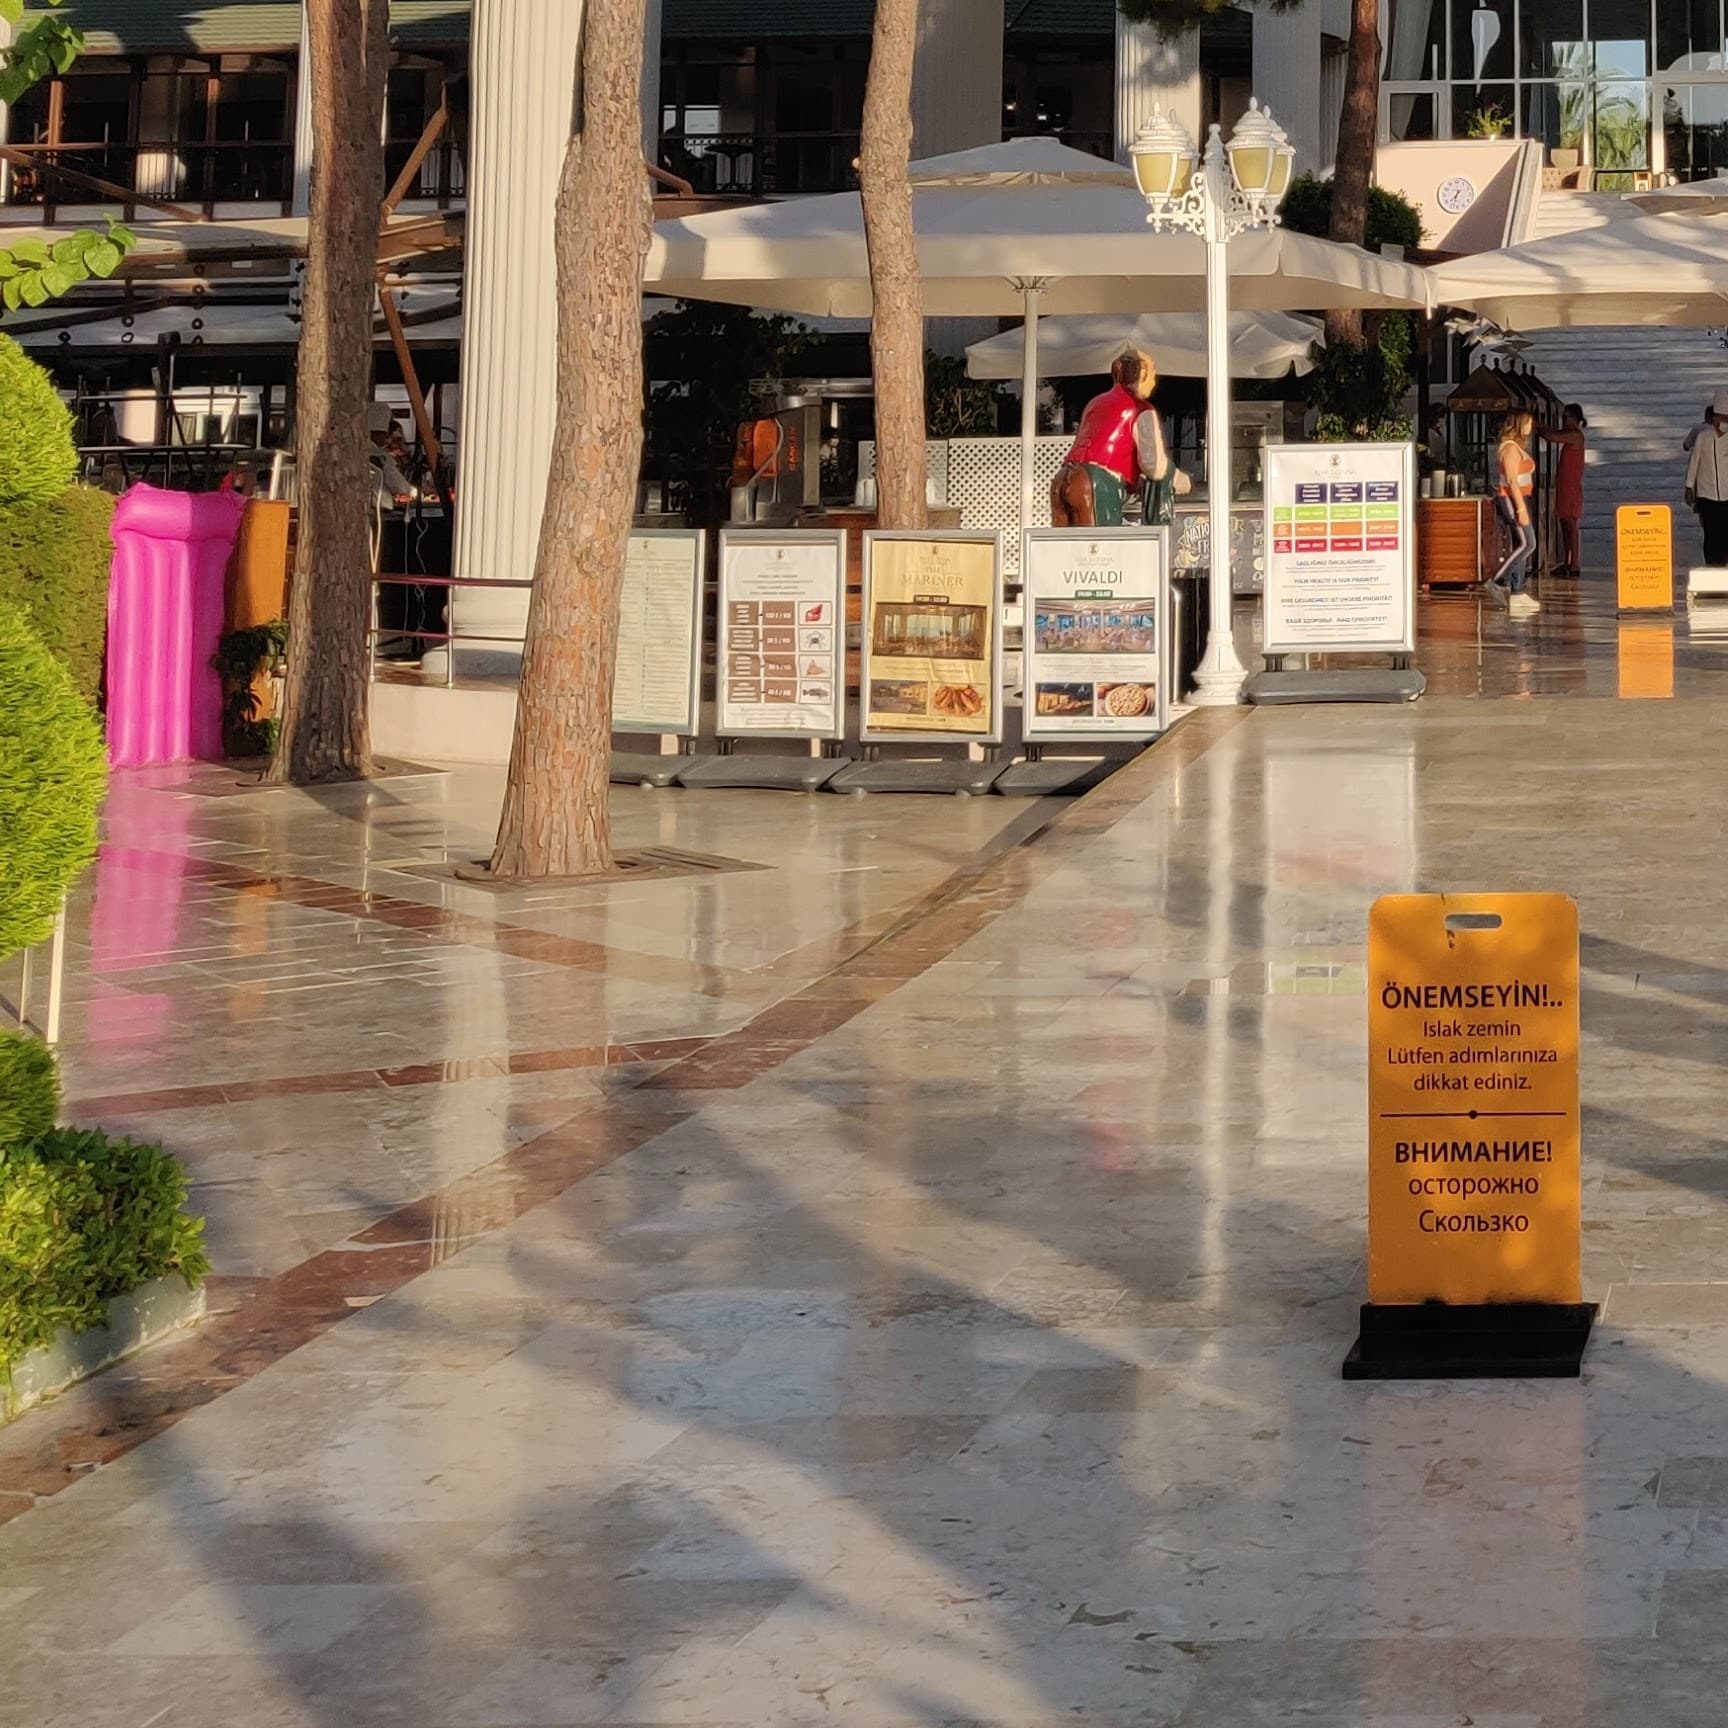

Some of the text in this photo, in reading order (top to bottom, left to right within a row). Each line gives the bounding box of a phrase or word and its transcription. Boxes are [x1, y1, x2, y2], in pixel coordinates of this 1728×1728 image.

[902, 574, 964, 587] MARINER
[1063, 570, 1123, 585] VIVALDI
[1381, 979, 1564, 1009] ÖNEMSEYİN!..
[1423, 1020, 1521, 1038] Islak zemin
[1387, 1045, 1558, 1064] Lütfen adımlarınıza
[1413, 1072, 1533, 1091] dikkat ediniz.
[1394, 1140, 1553, 1164] ВНИМАНИЕ!
[1408, 1176, 1540, 1201] осторожно
[1418, 1209, 1529, 1233] Скользко
